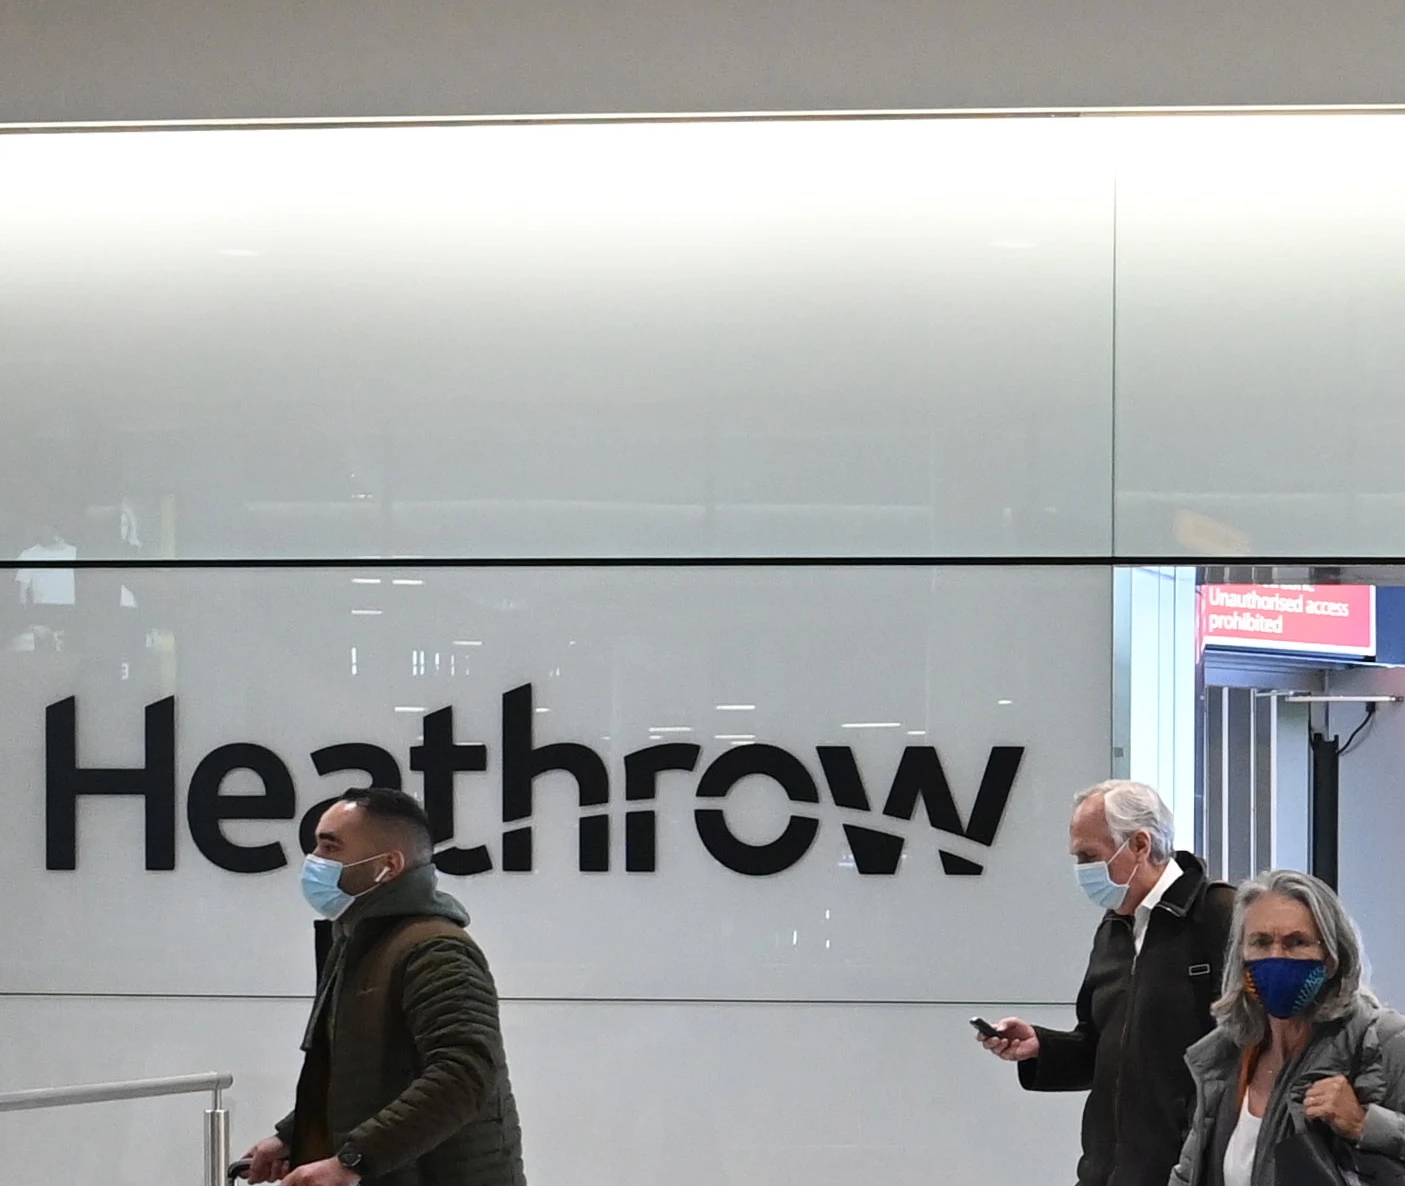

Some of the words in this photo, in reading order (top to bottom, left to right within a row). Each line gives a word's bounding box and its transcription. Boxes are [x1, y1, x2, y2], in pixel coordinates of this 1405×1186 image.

[1208, 587, 1303, 613] Unauthorised
[1305, 599, 1350, 617] access
[1208, 611, 1283, 633] prohibited
[45, 682, 1025, 876] Heathrow
